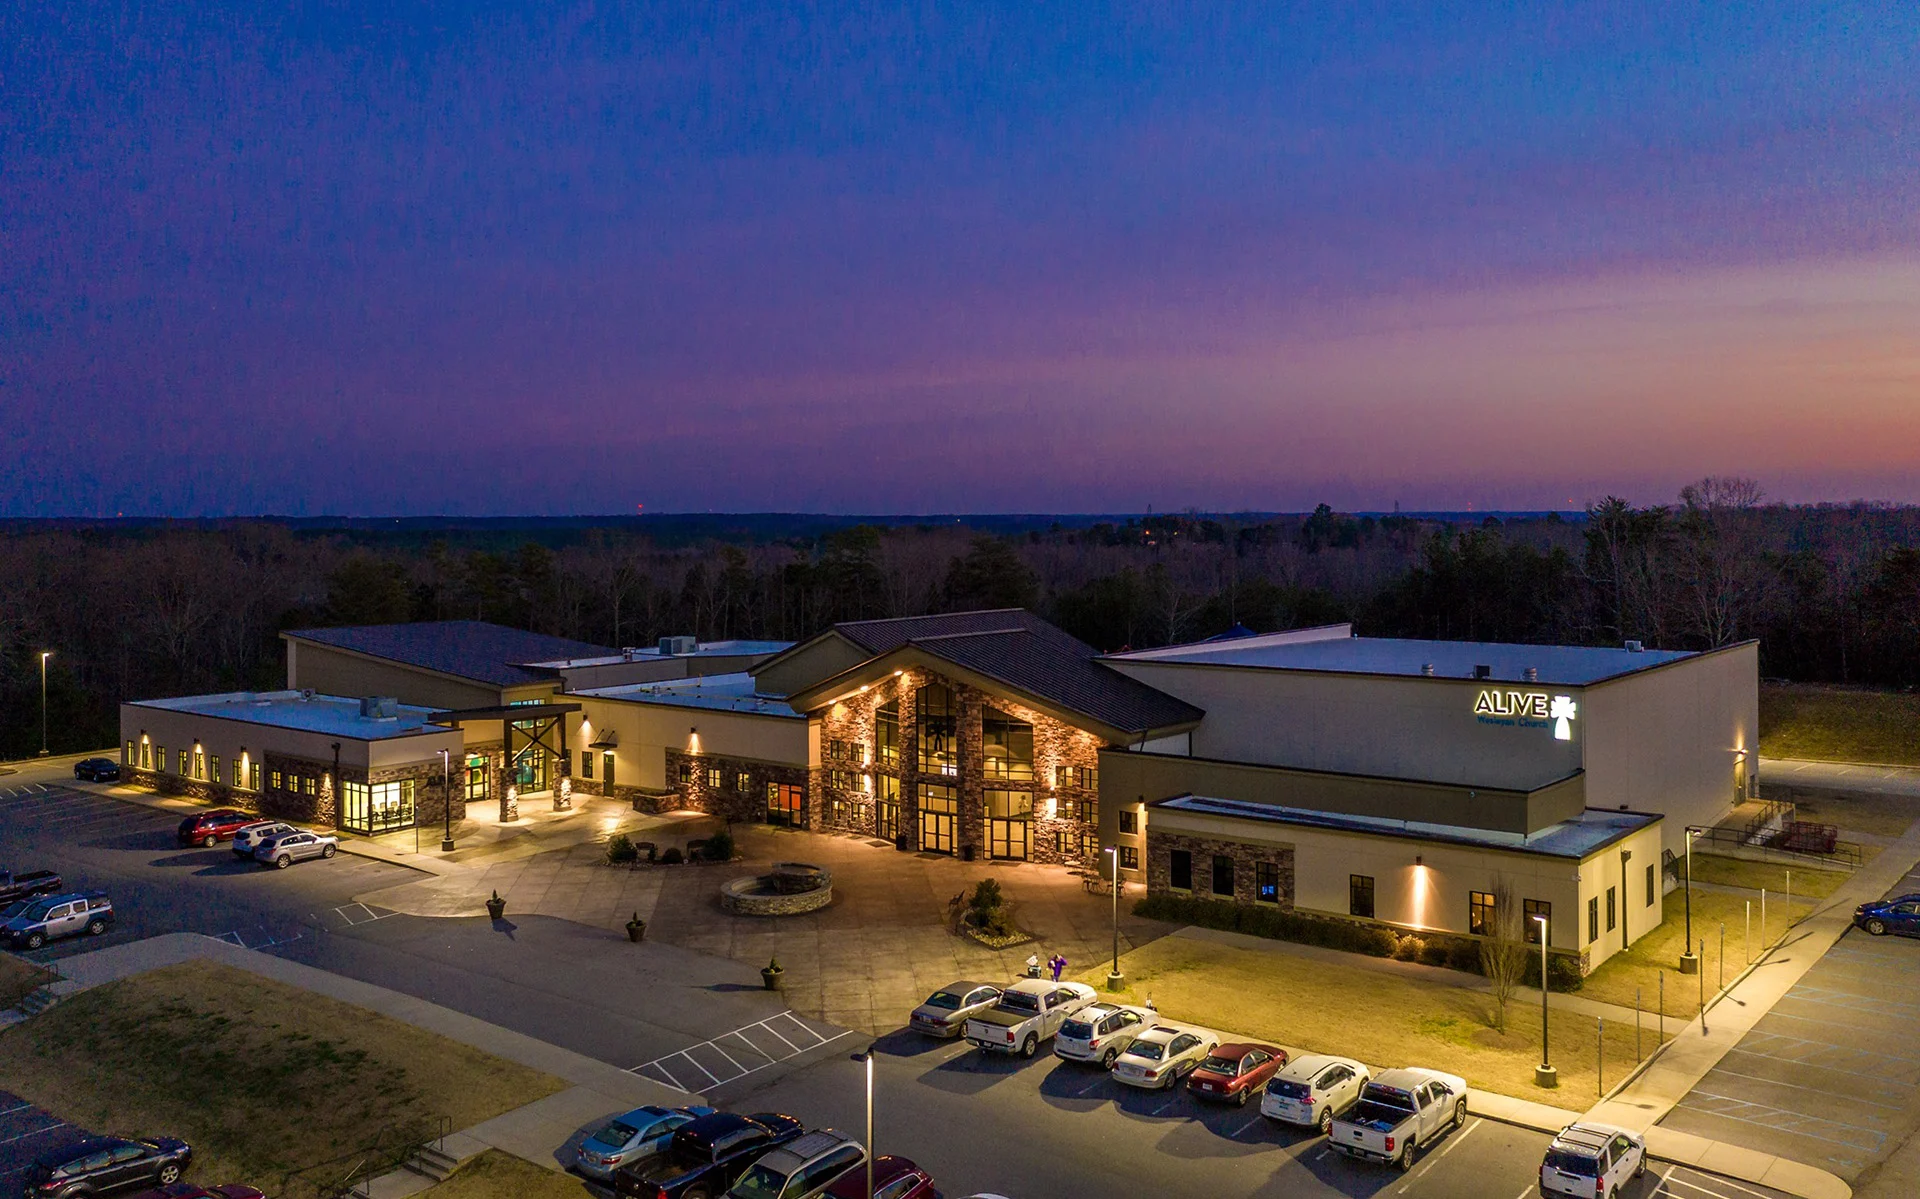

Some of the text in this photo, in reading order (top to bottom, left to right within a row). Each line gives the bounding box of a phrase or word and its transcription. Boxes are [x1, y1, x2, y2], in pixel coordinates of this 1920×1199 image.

[1474, 691, 1547, 717] ALIVE
[1477, 715, 1549, 729] Wesleyan Church
